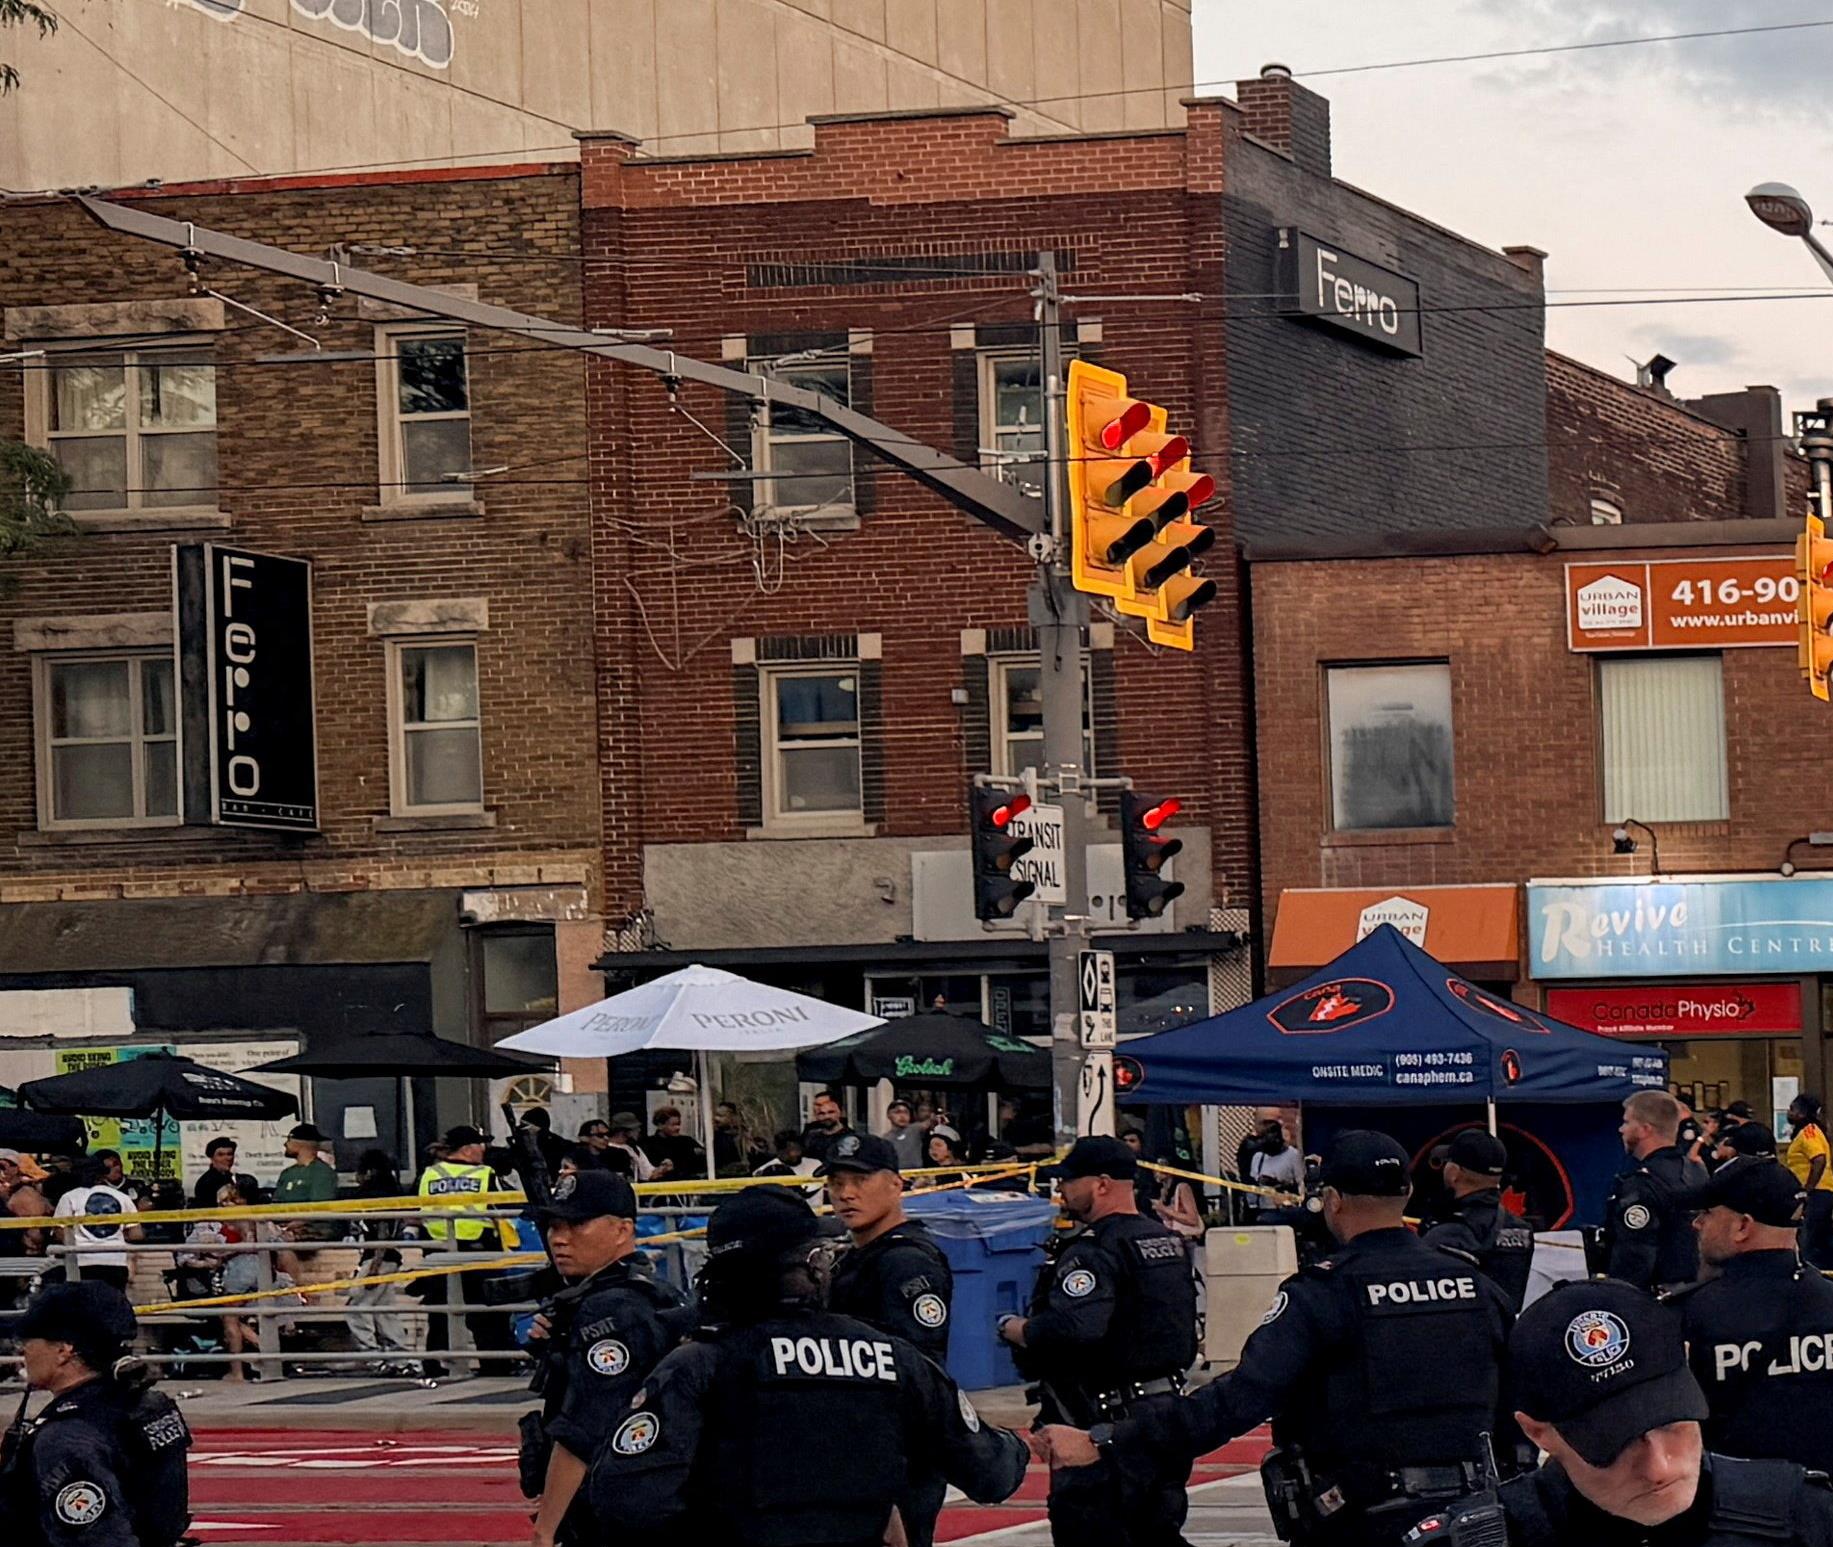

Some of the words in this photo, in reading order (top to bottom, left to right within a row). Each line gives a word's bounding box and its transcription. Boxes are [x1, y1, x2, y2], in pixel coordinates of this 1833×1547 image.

[1316, 247, 1399, 336] Ferro
[1580, 590, 1639, 602] URBAN
[1581, 602, 1639, 618] village
[1671, 611, 1799, 628] www.urbanvi
[223, 555, 260, 796] Ferro
[1010, 820, 1061, 850] TRANSIT
[1015, 860, 1060, 888] SIGNAL
[1362, 911, 1424, 923] URBAN
[1362, 922, 1422, 936] vige
[1542, 900, 1688, 963] Revive
[1596, 938, 1708, 957] HEALTH
[690, 1005, 812, 1032] PERONI
[1312, 1065, 1349, 1078] ONSITE
[1350, 1064, 1383, 1077] MEDIC
[428, 1178, 481, 1194] POLICE
[1367, 1276, 1477, 1306] POLICE
[771, 1336, 898, 1381] POLICE
